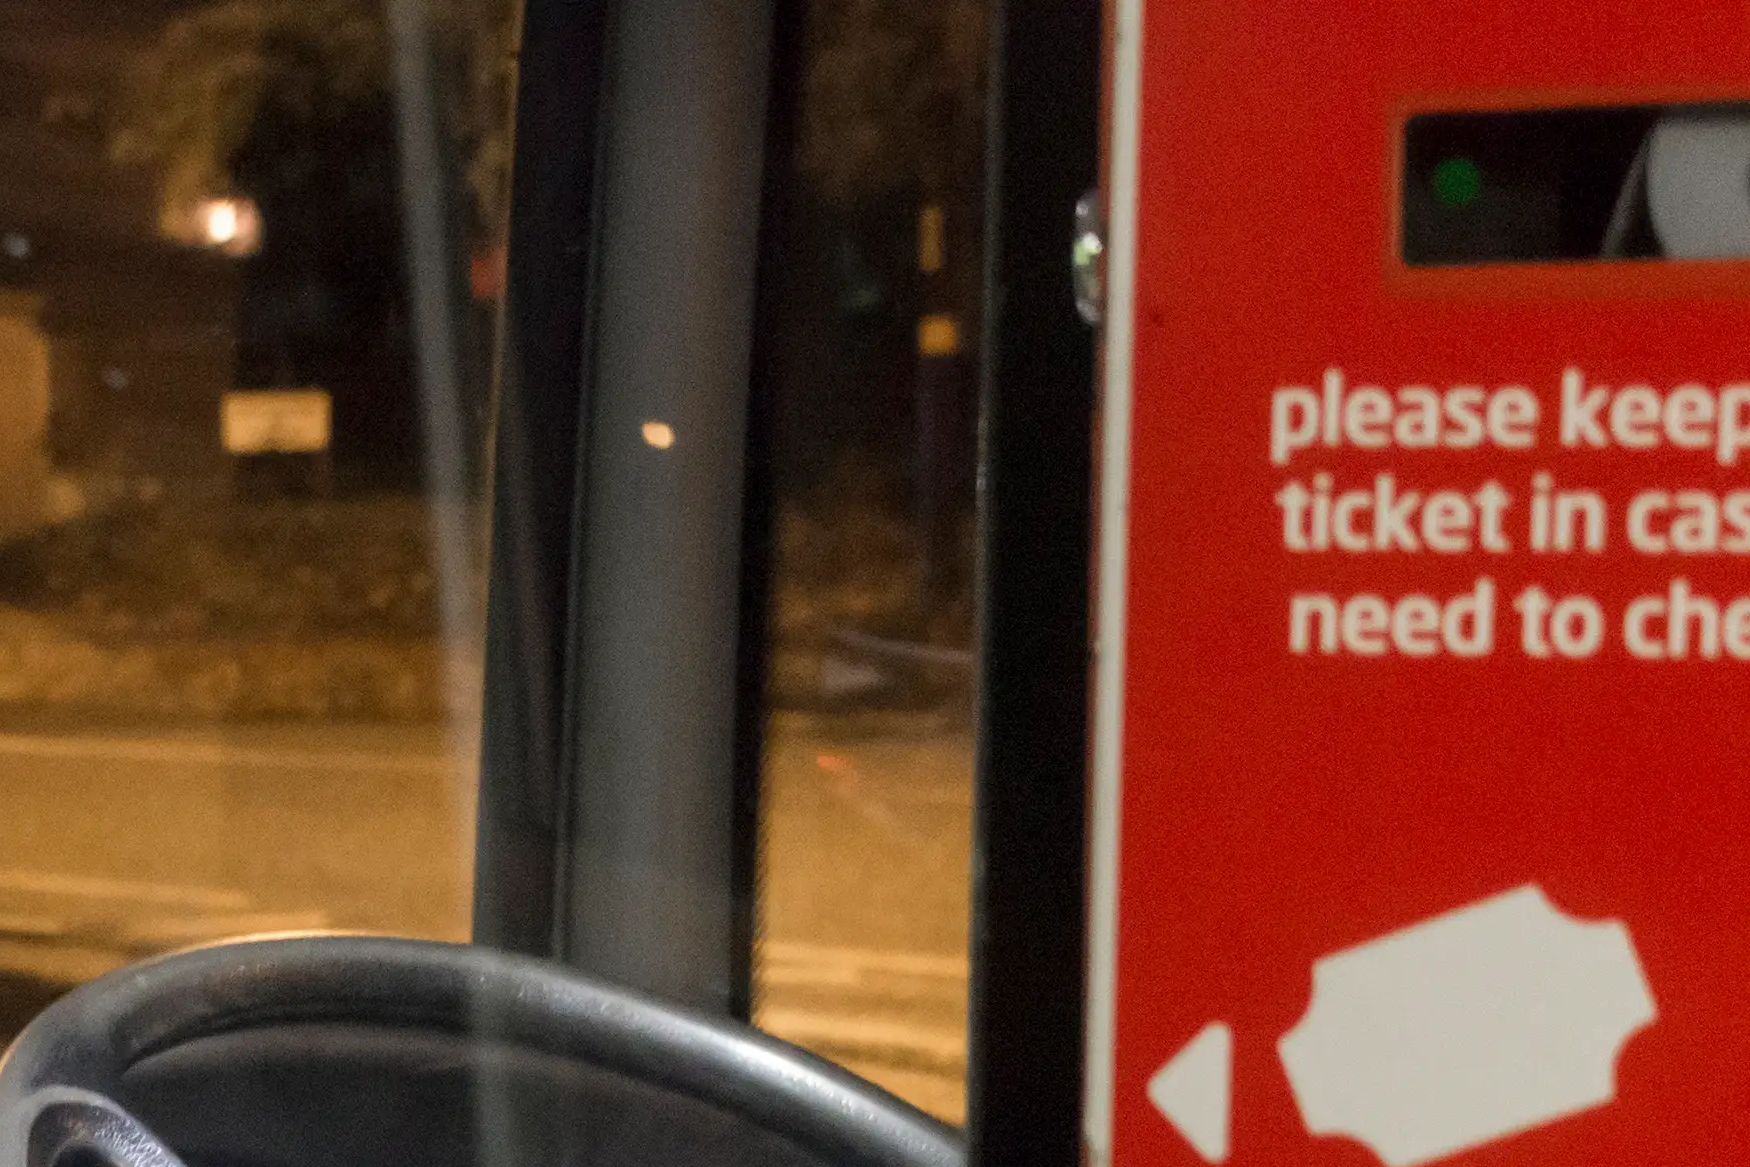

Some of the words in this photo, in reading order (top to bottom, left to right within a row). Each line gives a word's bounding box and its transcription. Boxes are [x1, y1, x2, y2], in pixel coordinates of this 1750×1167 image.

[1270, 366, 1539, 466] please
[1560, 366, 1750, 466] keep
[1275, 472, 1511, 553] ticket
[1530, 472, 1607, 553] in
[1626, 488, 1750, 554] cas
[1289, 576, 1496, 658] need
[1513, 585, 1604, 659] to
